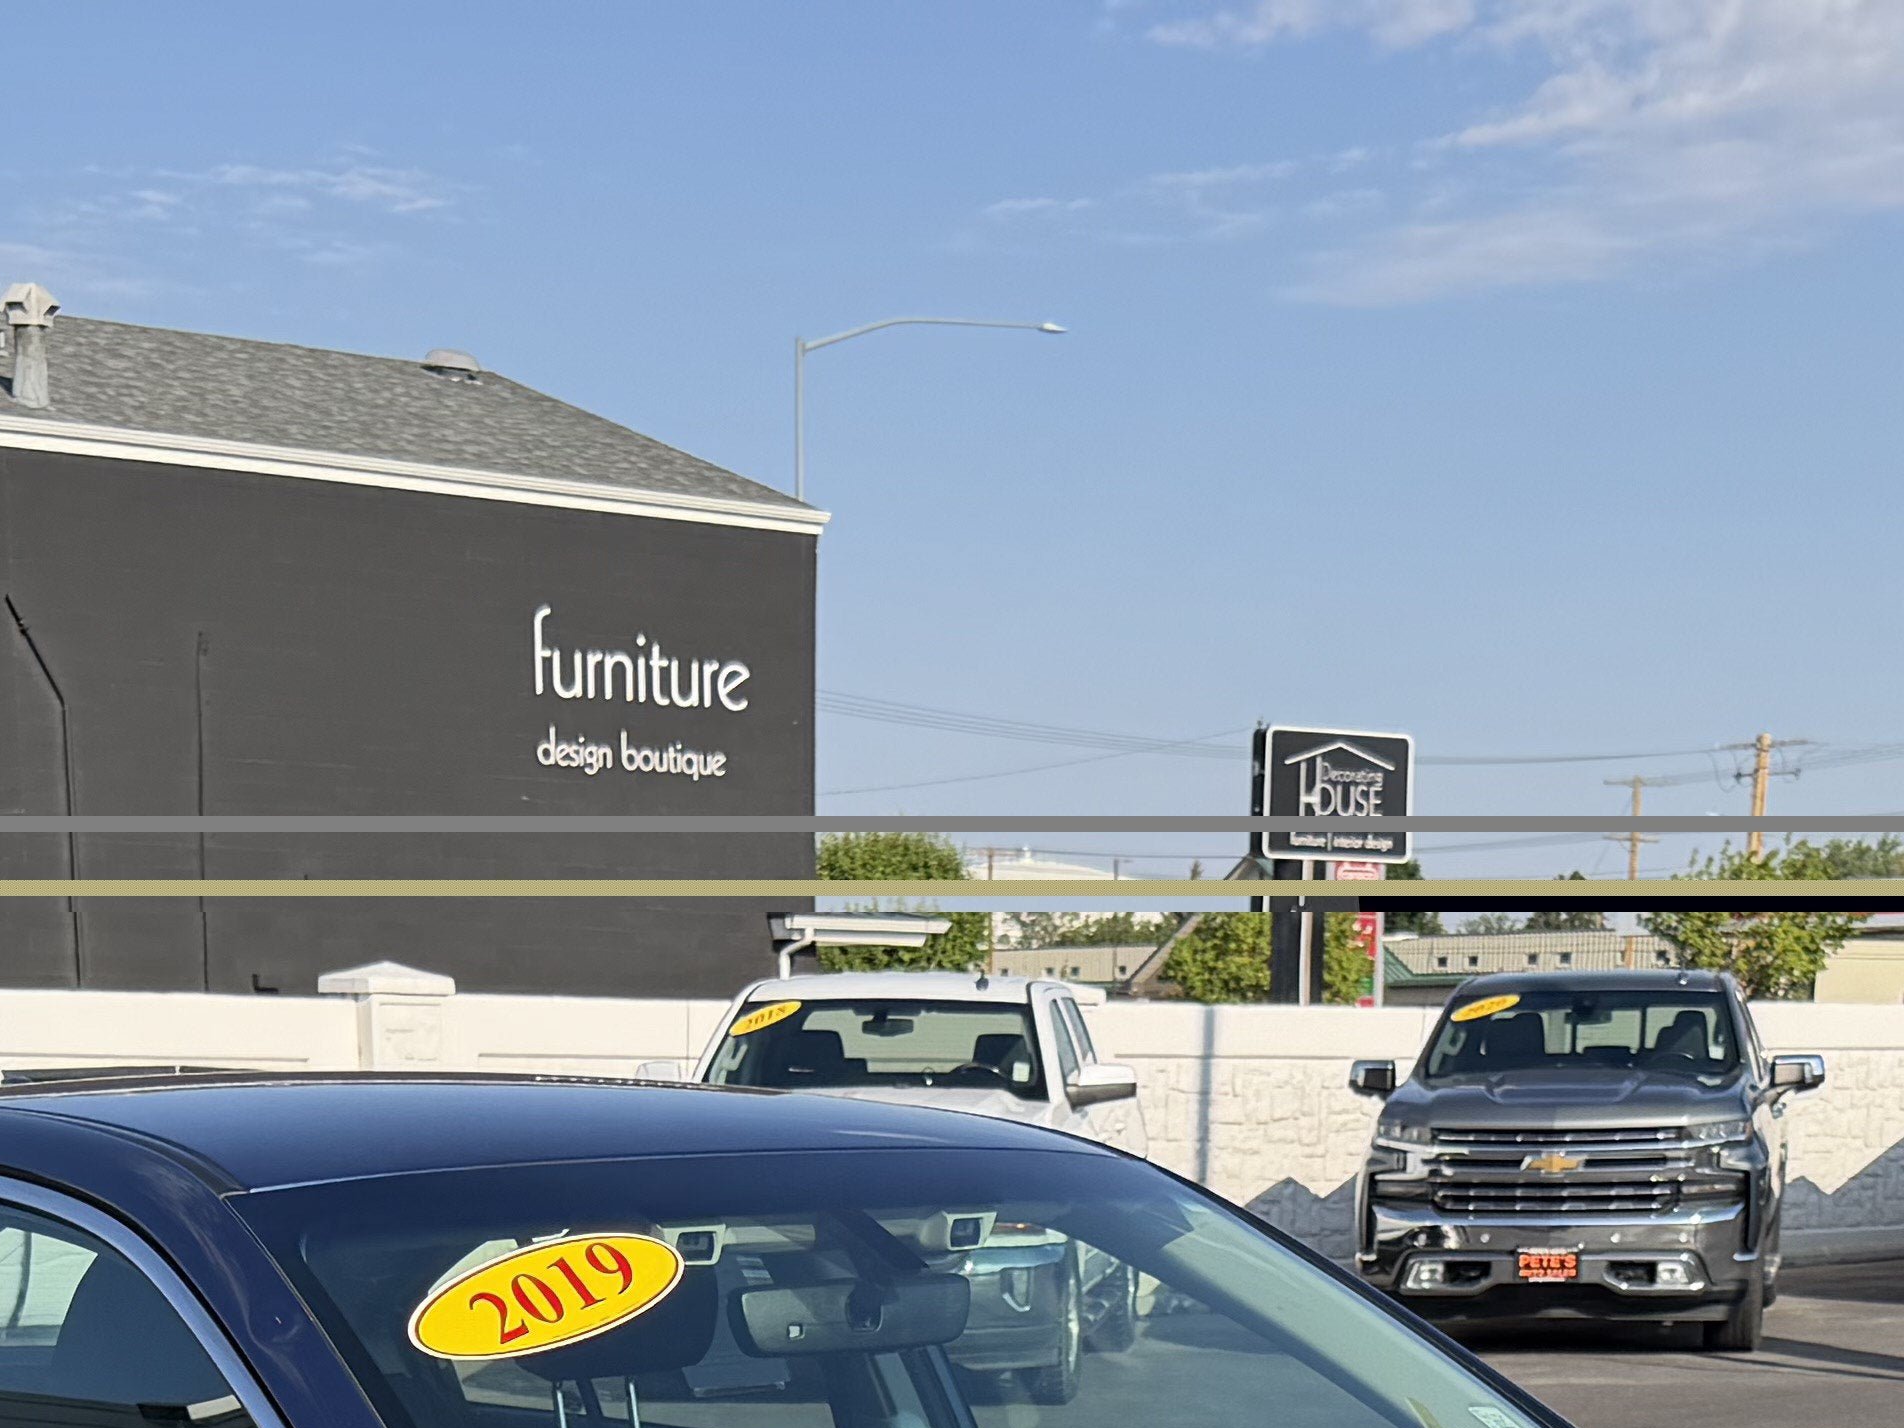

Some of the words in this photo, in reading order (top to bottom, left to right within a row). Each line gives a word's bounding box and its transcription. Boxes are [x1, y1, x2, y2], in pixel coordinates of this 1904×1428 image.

[533, 603, 751, 712] furniture
[536, 723, 613, 775] design
[620, 728, 727, 781] boutique
[469, 1242, 634, 1344] 2019
[1519, 1254, 1576, 1268] PETE'S
